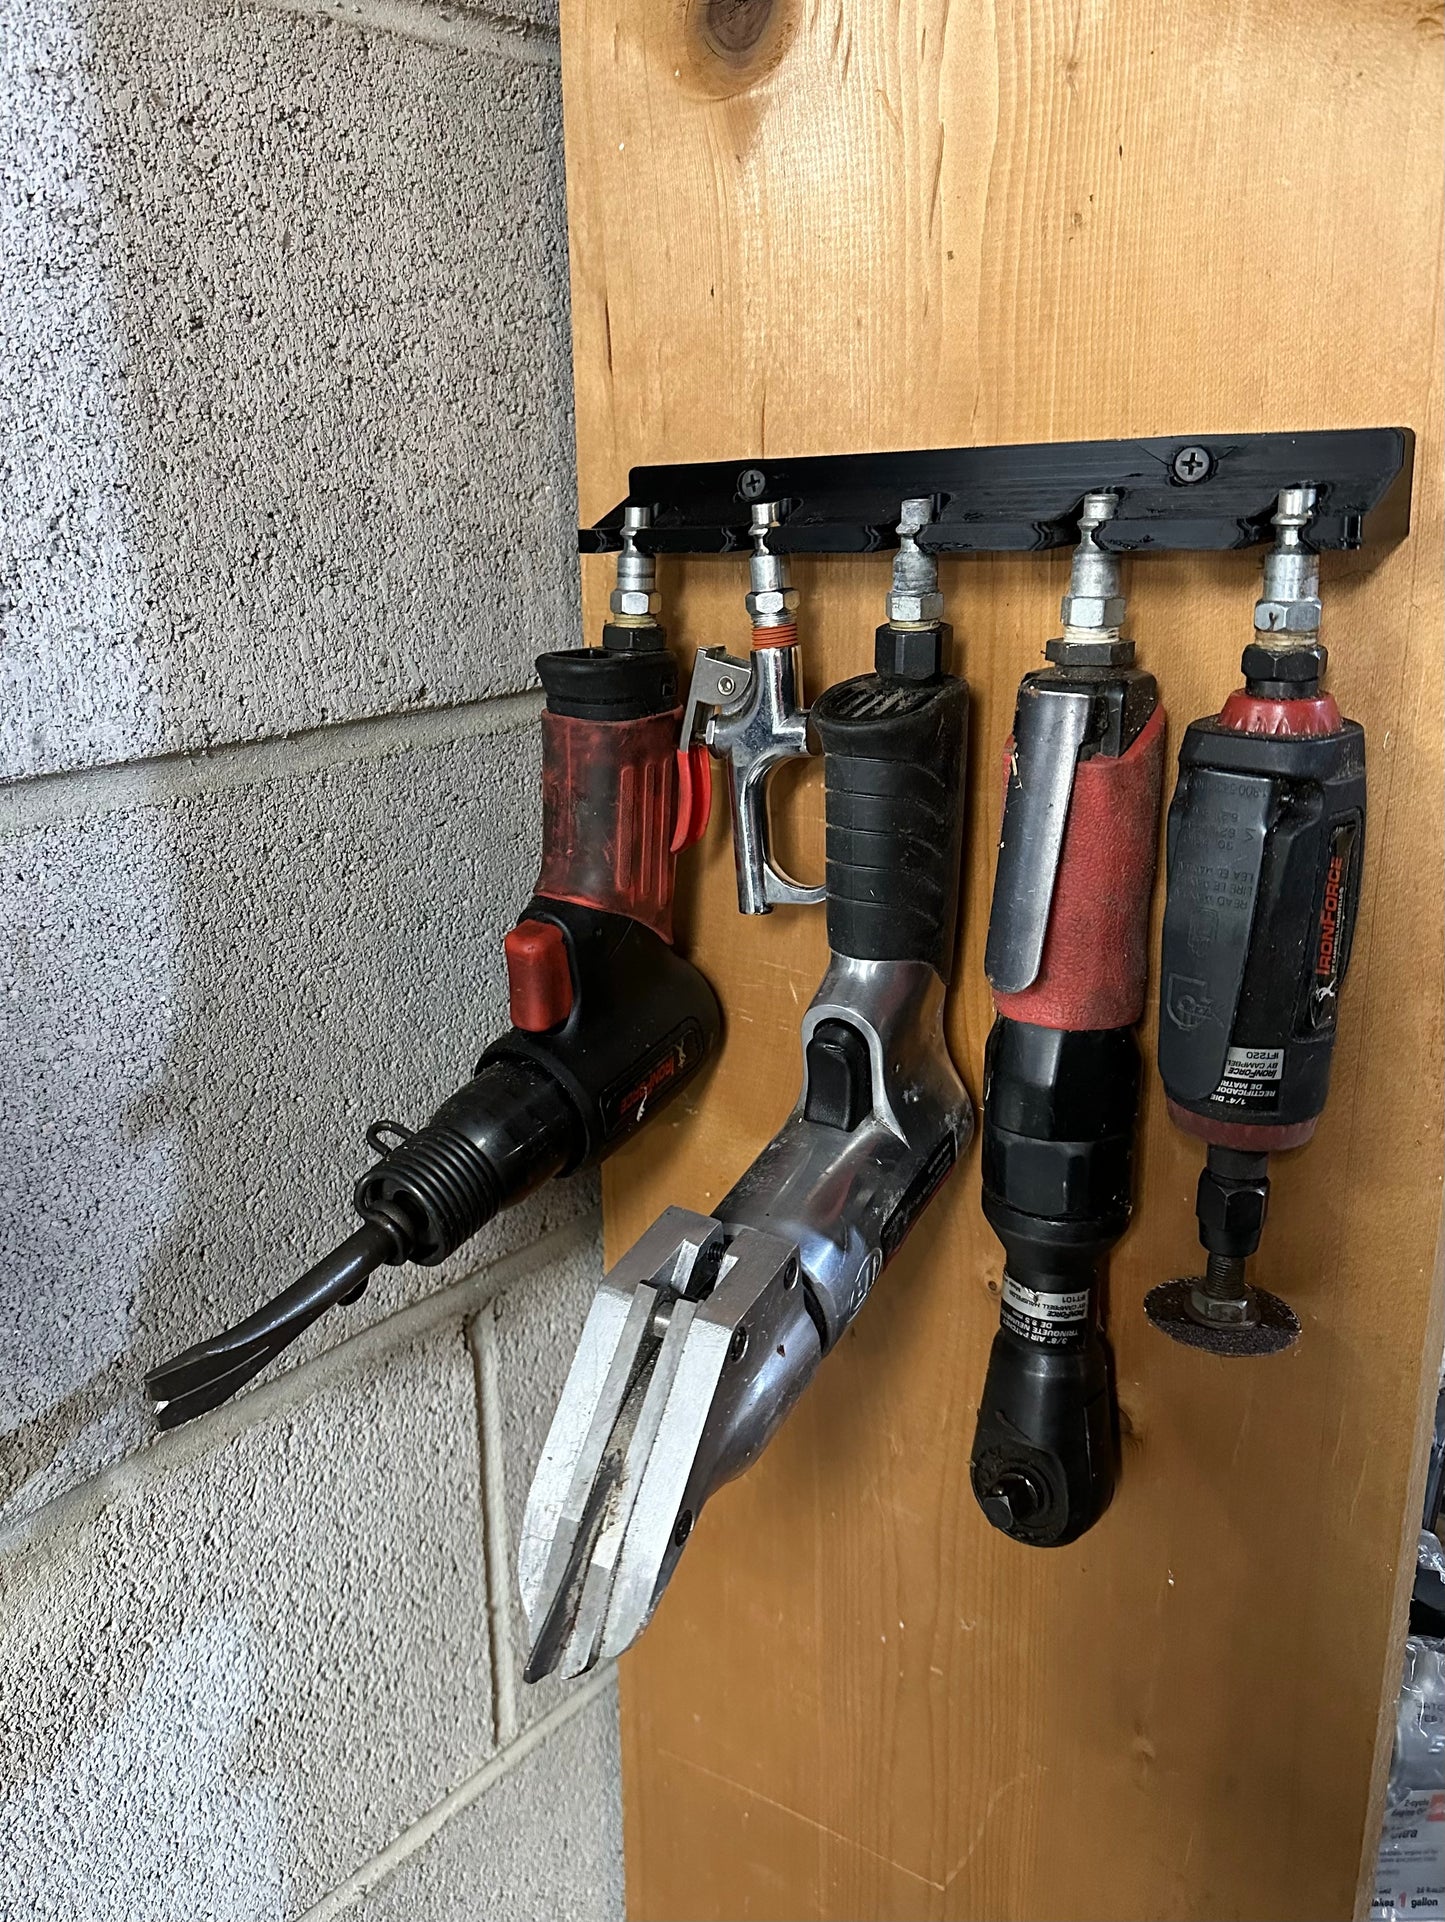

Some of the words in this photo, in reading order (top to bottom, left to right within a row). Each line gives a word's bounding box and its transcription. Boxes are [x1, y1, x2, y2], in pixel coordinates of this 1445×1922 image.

[1233, 870, 1254, 883] LEA
[1217, 896, 1248, 910] READ
[1314, 856, 1344, 976] IRONFORCE
[1246, 1052, 1280, 1060] IFT220
[1228, 1067, 1278, 1078] IRONFORCE
[1210, 1093, 1225, 1102] DIE
[1042, 1303, 1078, 1311] CAMPBELL
[1031, 1326, 1079, 1336] TRINQUETE
[1031, 1333, 1046, 1342] AIR
[1371, 1898, 1395, 1907] akes
[1398, 1890, 1407, 1908] 1
[1411, 1897, 1438, 1909] gallon
